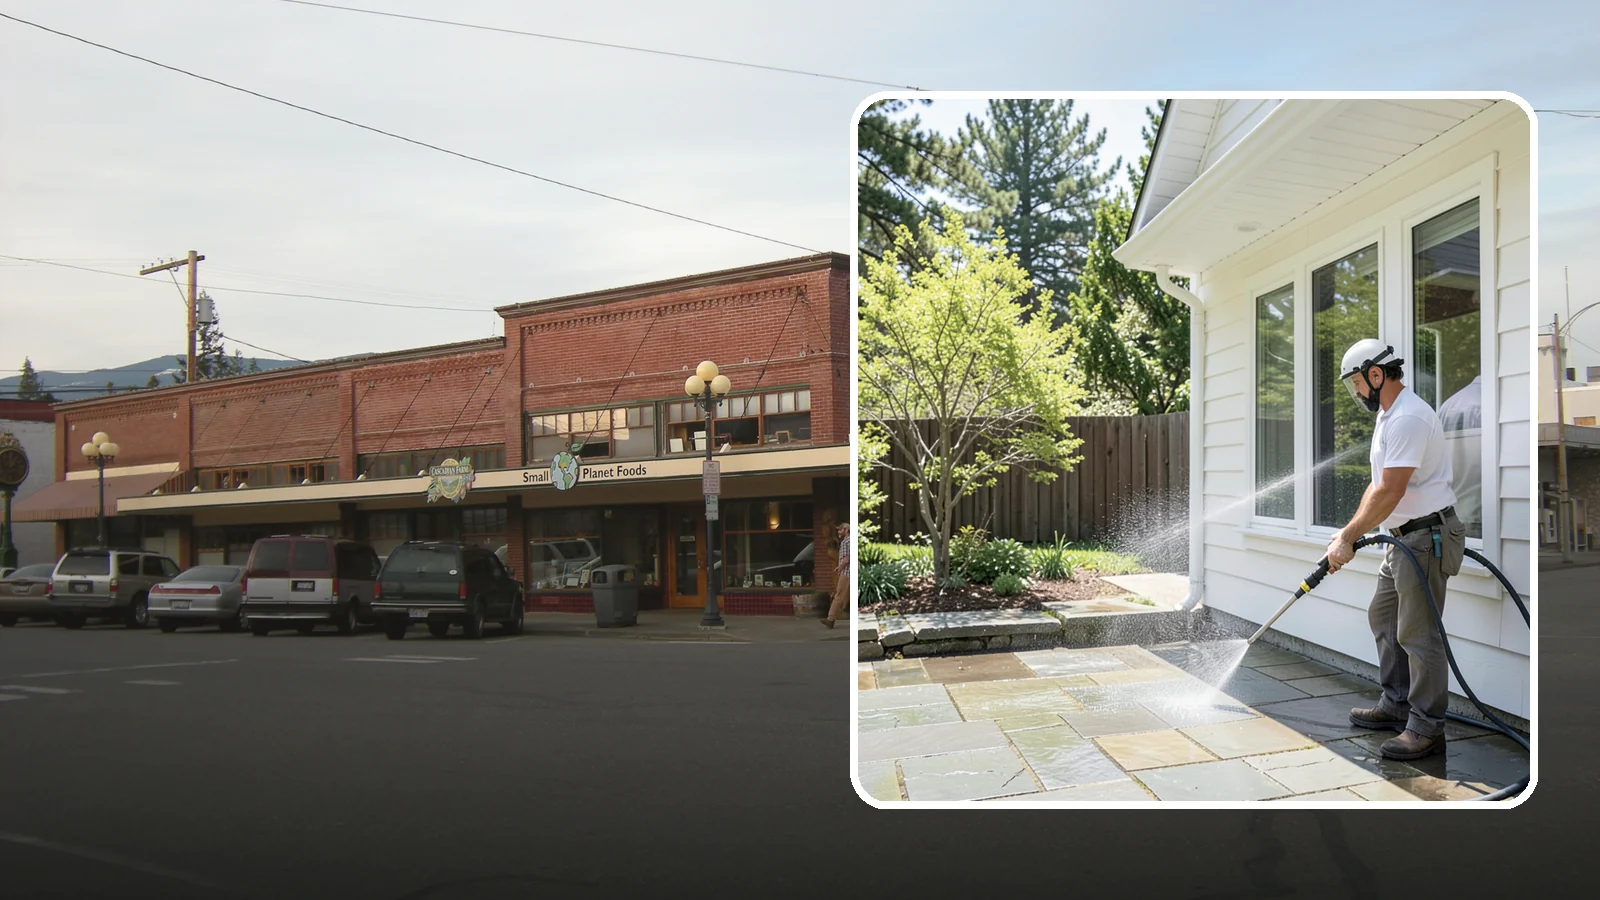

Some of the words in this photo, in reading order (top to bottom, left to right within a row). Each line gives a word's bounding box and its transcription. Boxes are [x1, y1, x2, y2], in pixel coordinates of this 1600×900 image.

[522, 472, 549, 483] Small
[583, 467, 614, 479] Planet
[616, 464, 647, 477] Foods
